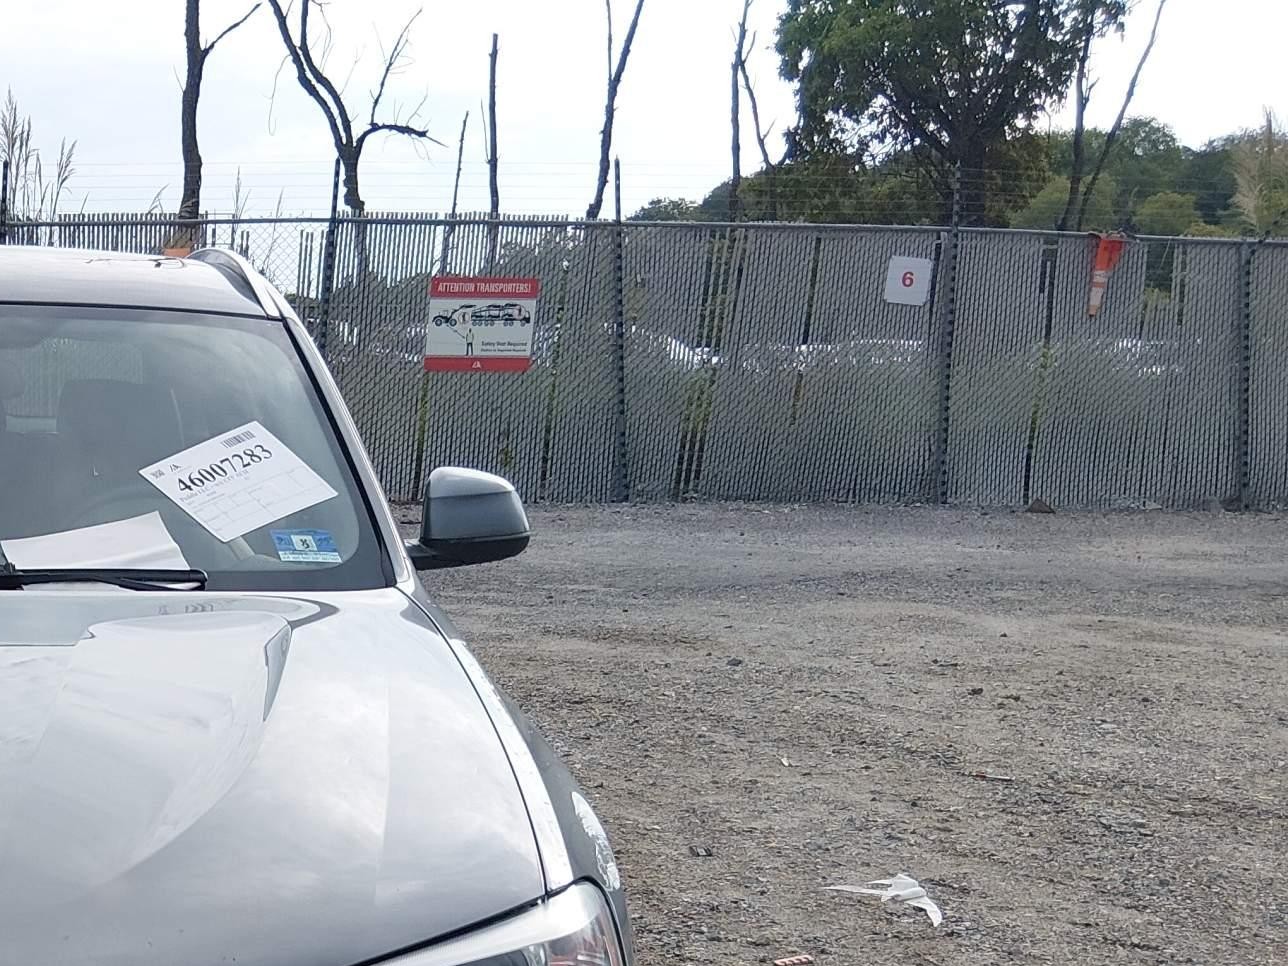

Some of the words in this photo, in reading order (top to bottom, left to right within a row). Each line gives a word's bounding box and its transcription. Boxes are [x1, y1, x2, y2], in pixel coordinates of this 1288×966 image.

[438, 282, 475, 293] ATTENTION
[476, 282, 532, 294] TRANSPORTERS!
[902, 271, 914, 288] 6
[177, 444, 273, 492] 46007283
